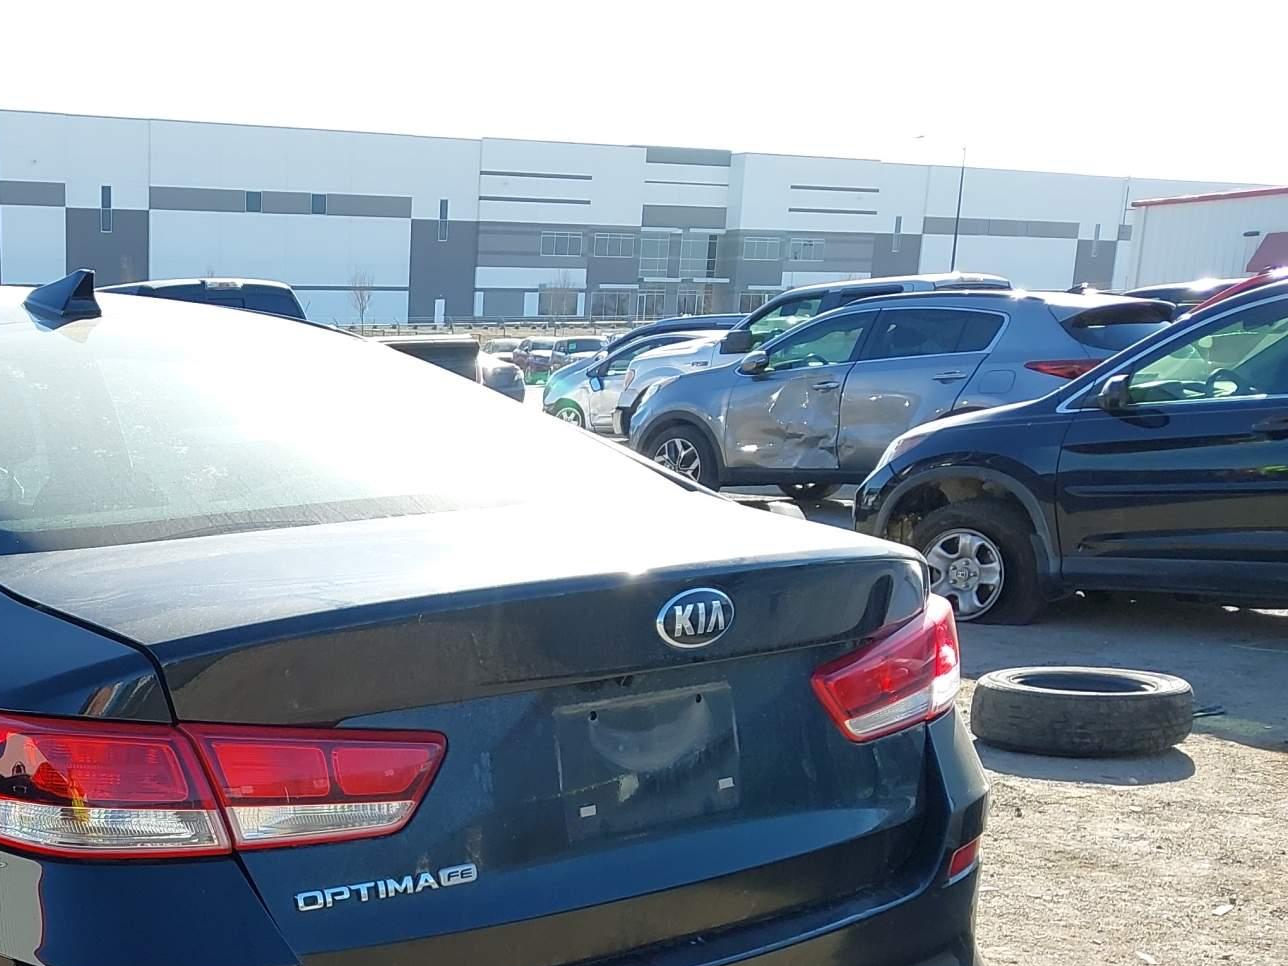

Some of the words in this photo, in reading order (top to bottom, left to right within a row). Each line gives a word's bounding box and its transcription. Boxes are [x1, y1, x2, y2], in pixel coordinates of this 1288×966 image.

[673, 600, 725, 637] KIA
[295, 871, 440, 912] OPTIMA
[443, 865, 475, 884] FE
